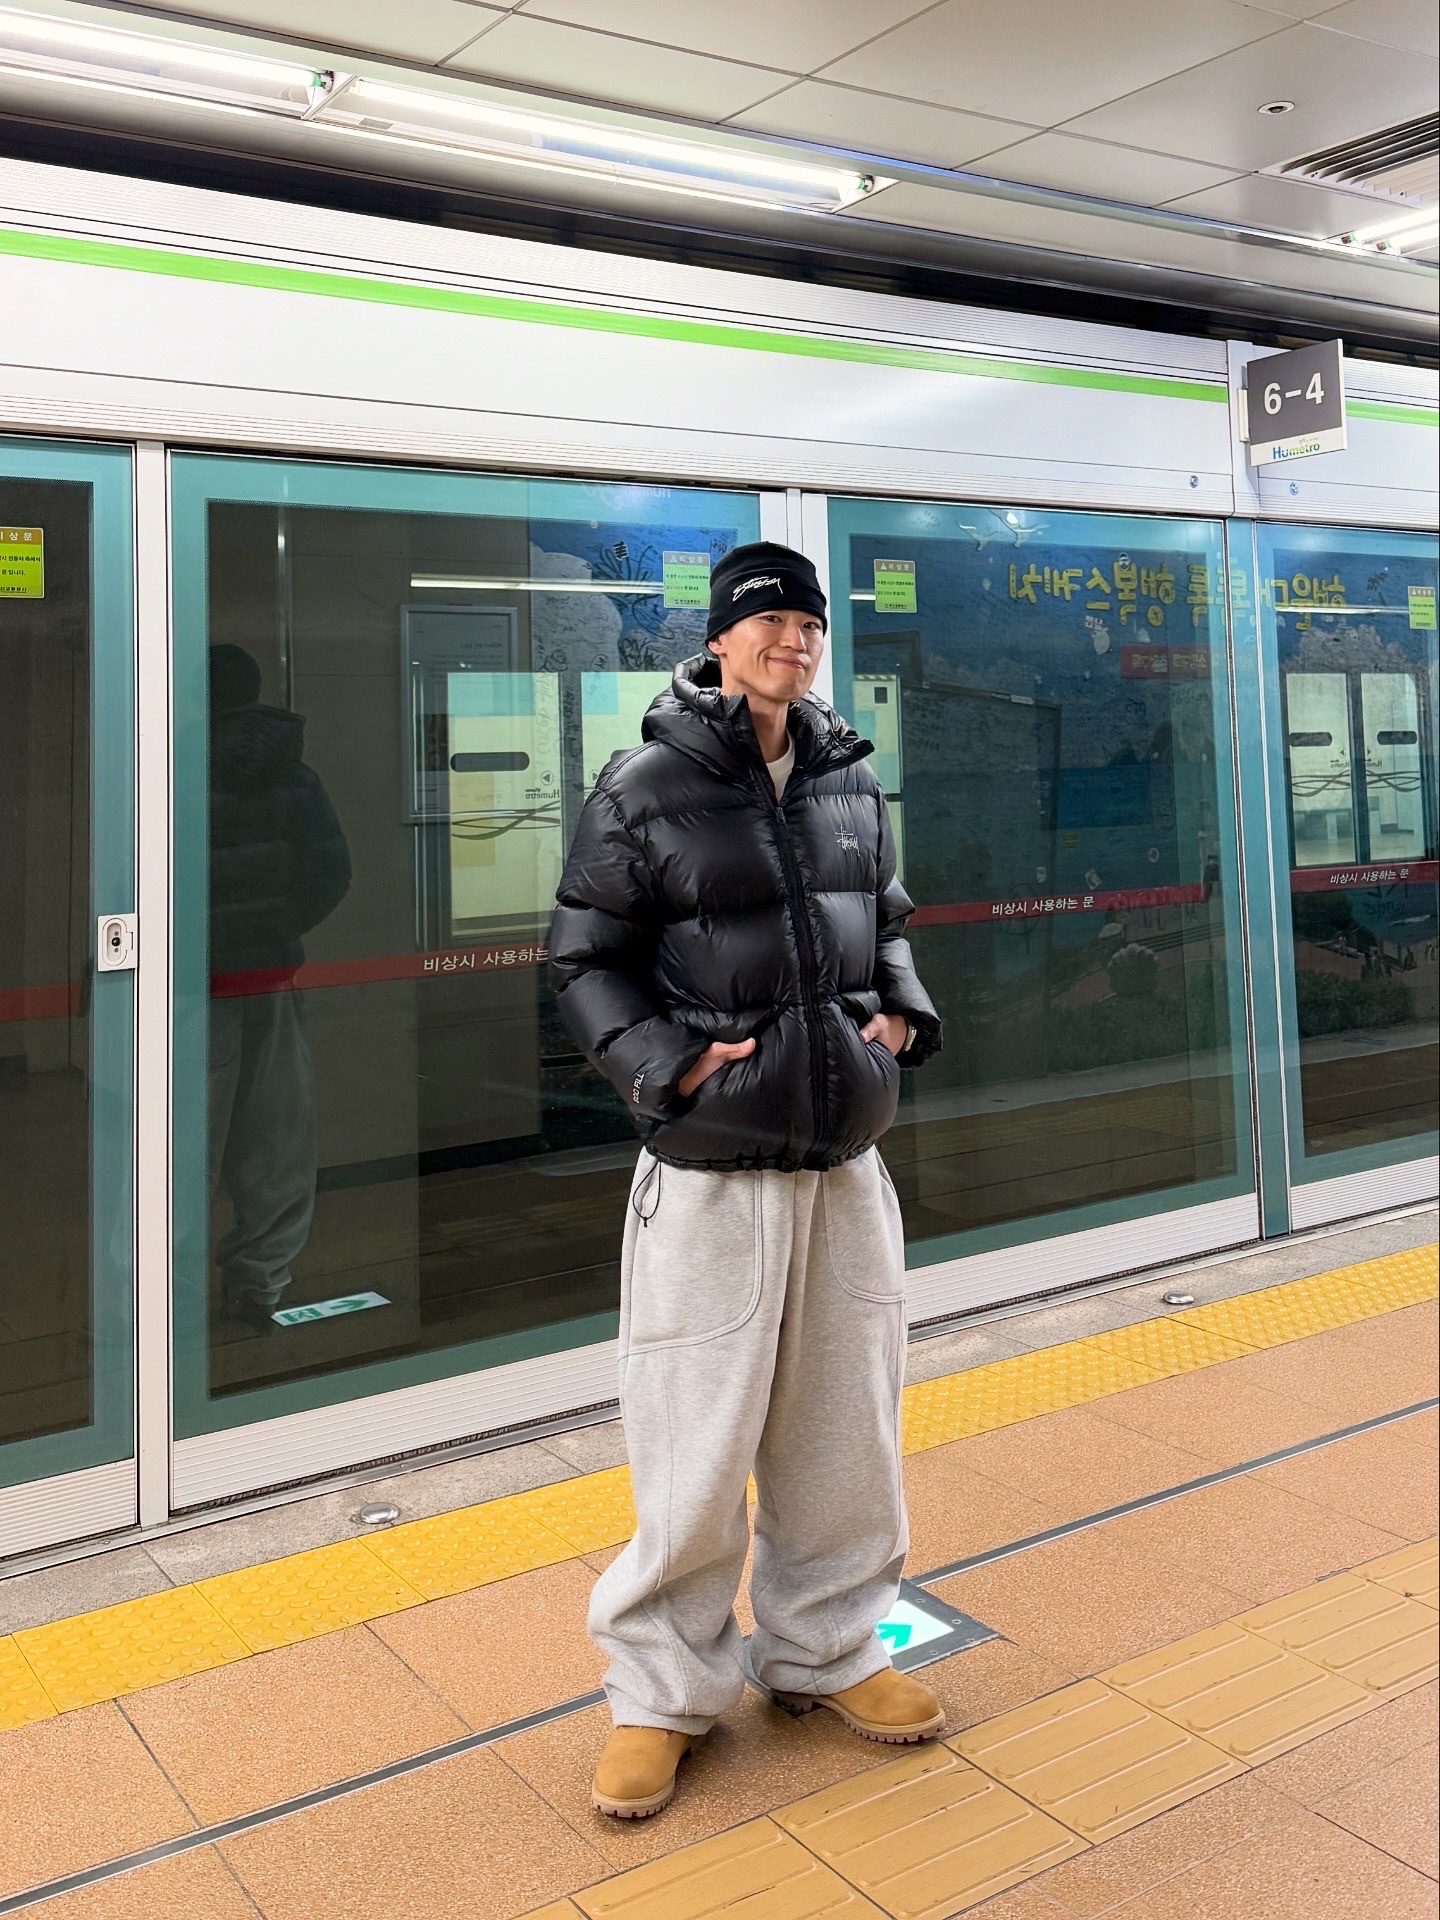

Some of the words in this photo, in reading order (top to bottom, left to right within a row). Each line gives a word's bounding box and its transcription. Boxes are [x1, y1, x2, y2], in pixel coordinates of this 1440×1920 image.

[1264, 372, 1324, 415] 6-4
[1273, 443, 1320, 460] Humetro
[1330, 872, 1358, 884] 비상시
[1361, 869, 1397, 882] 사용하는
[1400, 868, 1409, 879] 문
[992, 901, 1027, 915] 비상시
[1032, 897, 1078, 912] 사용하는
[1083, 896, 1094, 908] 문
[423, 953, 475, 972] 비상시
[483, 947, 549, 966] 사용하는
